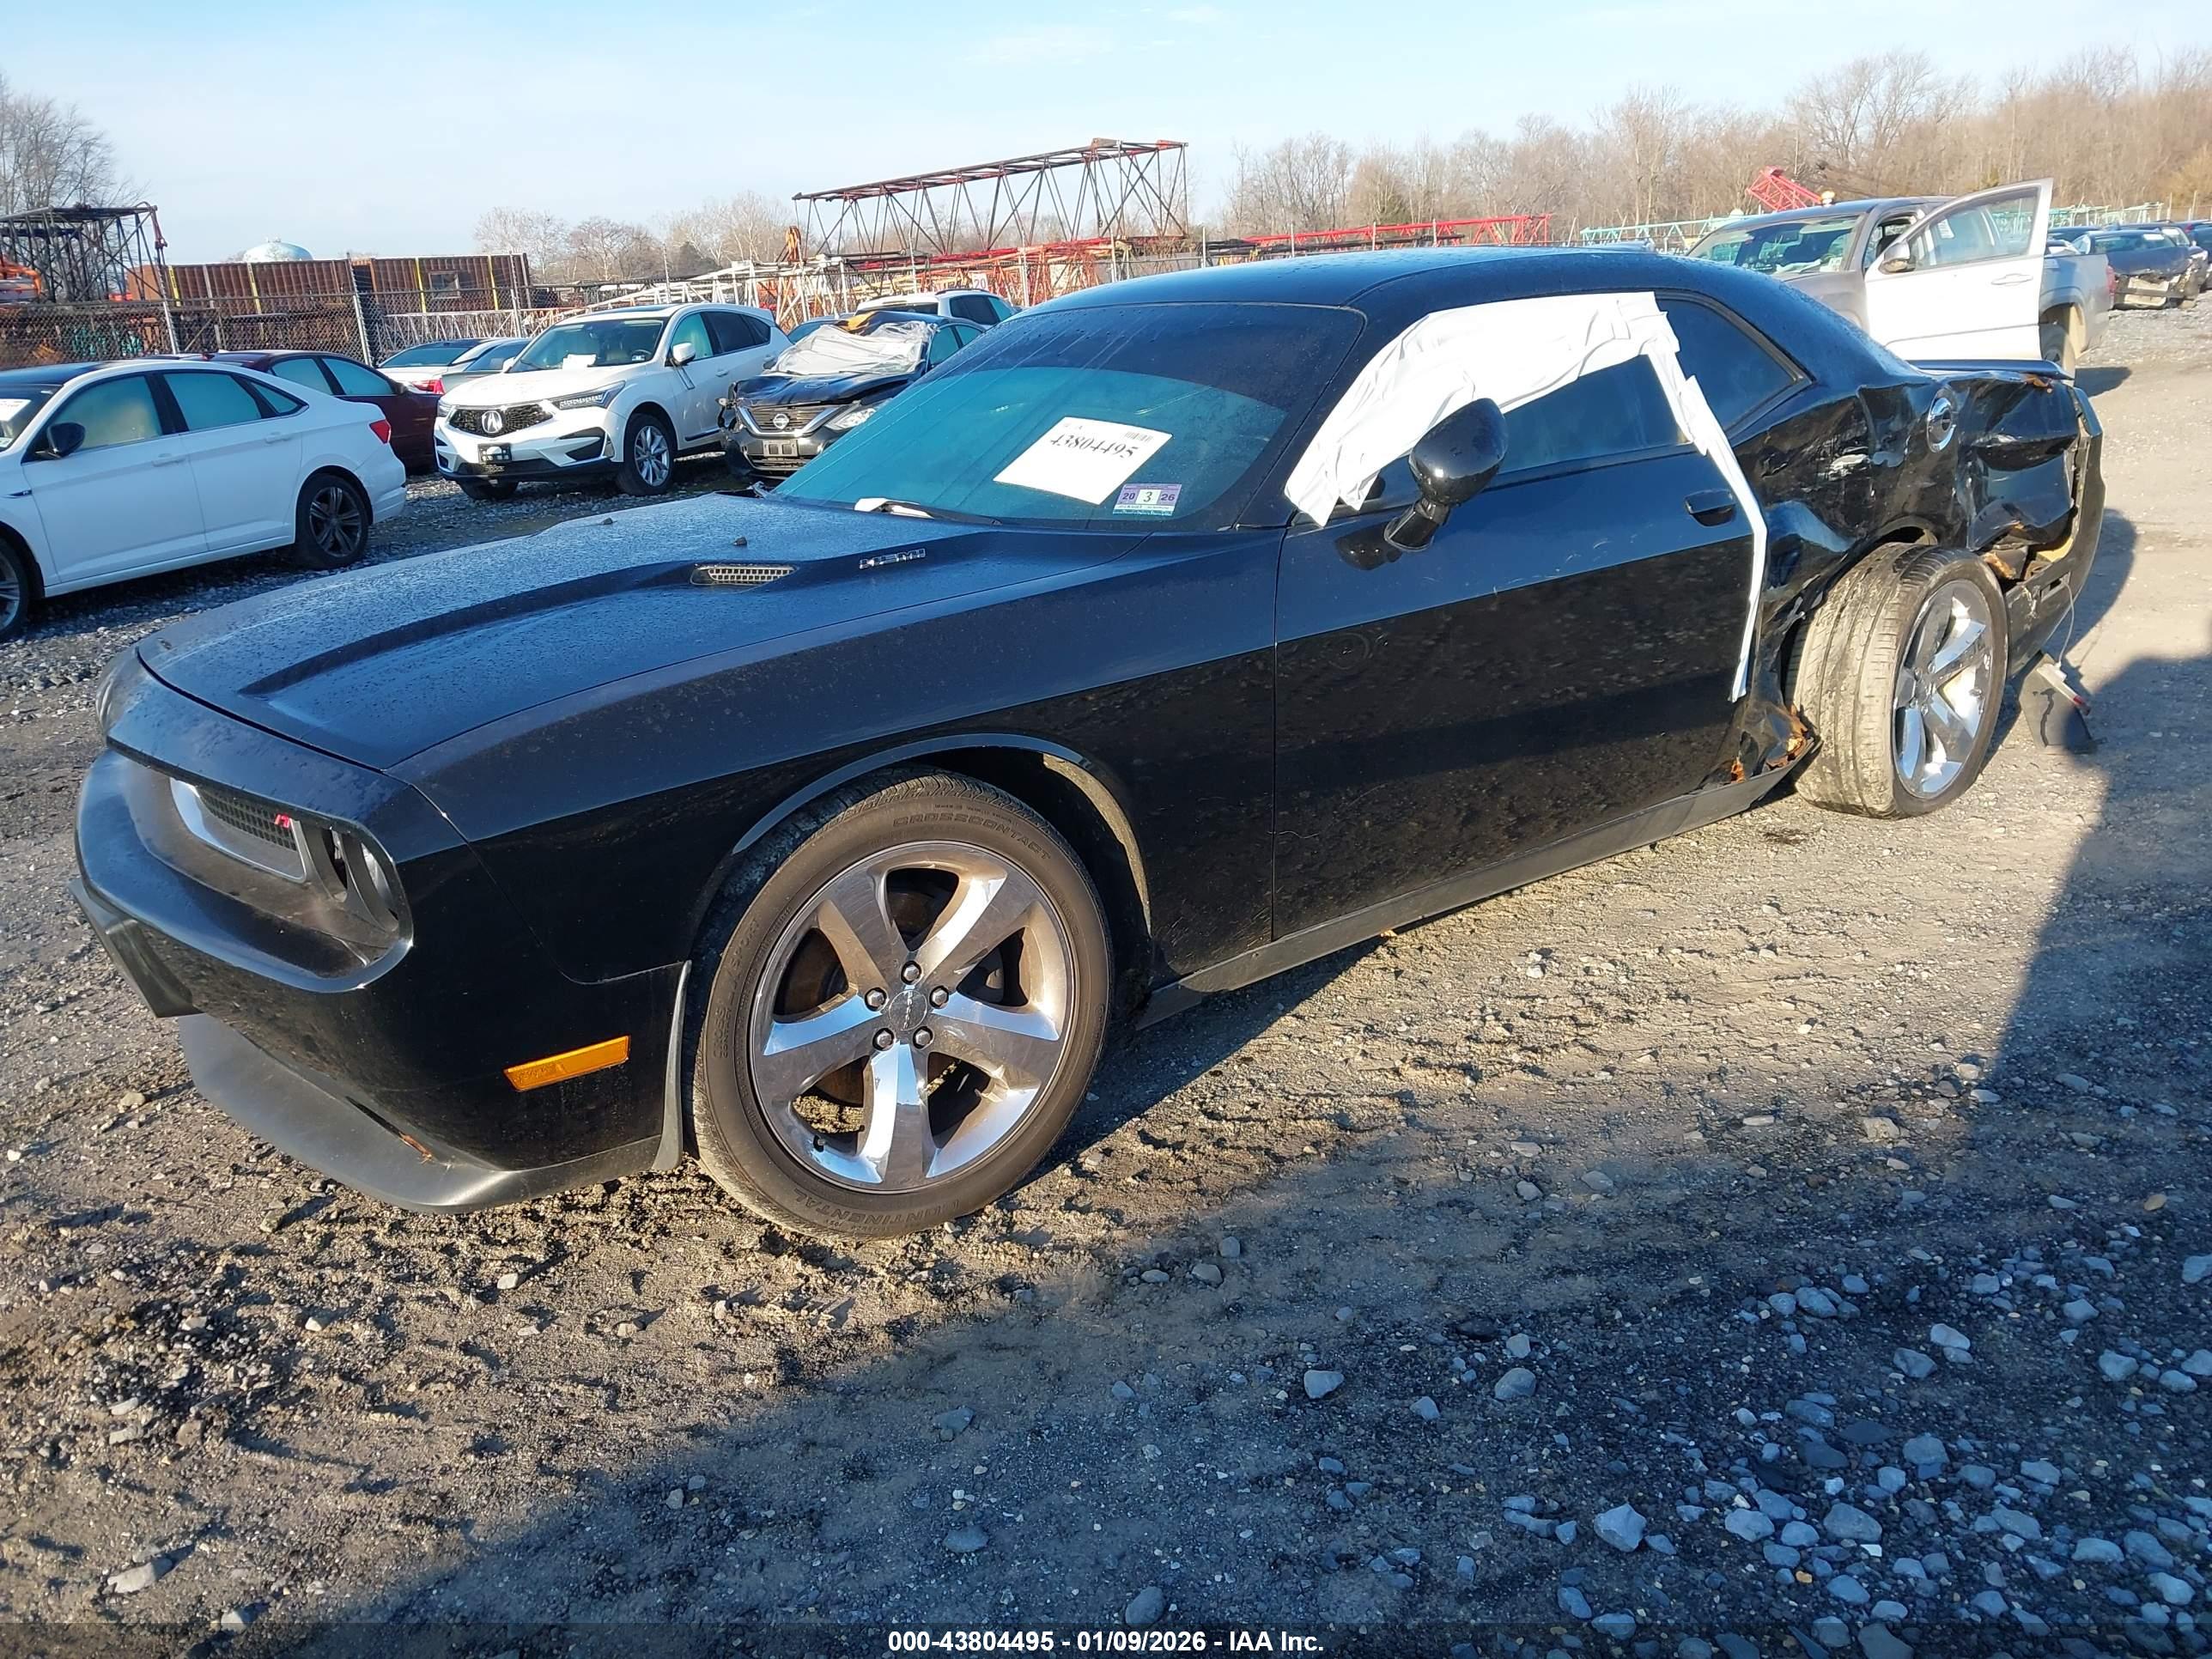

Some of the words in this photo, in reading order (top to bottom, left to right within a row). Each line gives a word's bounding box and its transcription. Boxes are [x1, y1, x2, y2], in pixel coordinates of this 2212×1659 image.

[1050, 433, 1139, 459] 43804495
[1121, 492, 1135, 501] 20
[1143, 491, 1153, 502] 3
[1160, 493, 1176, 501] 26
[892, 812, 1052, 860] CROSSCONTACT
